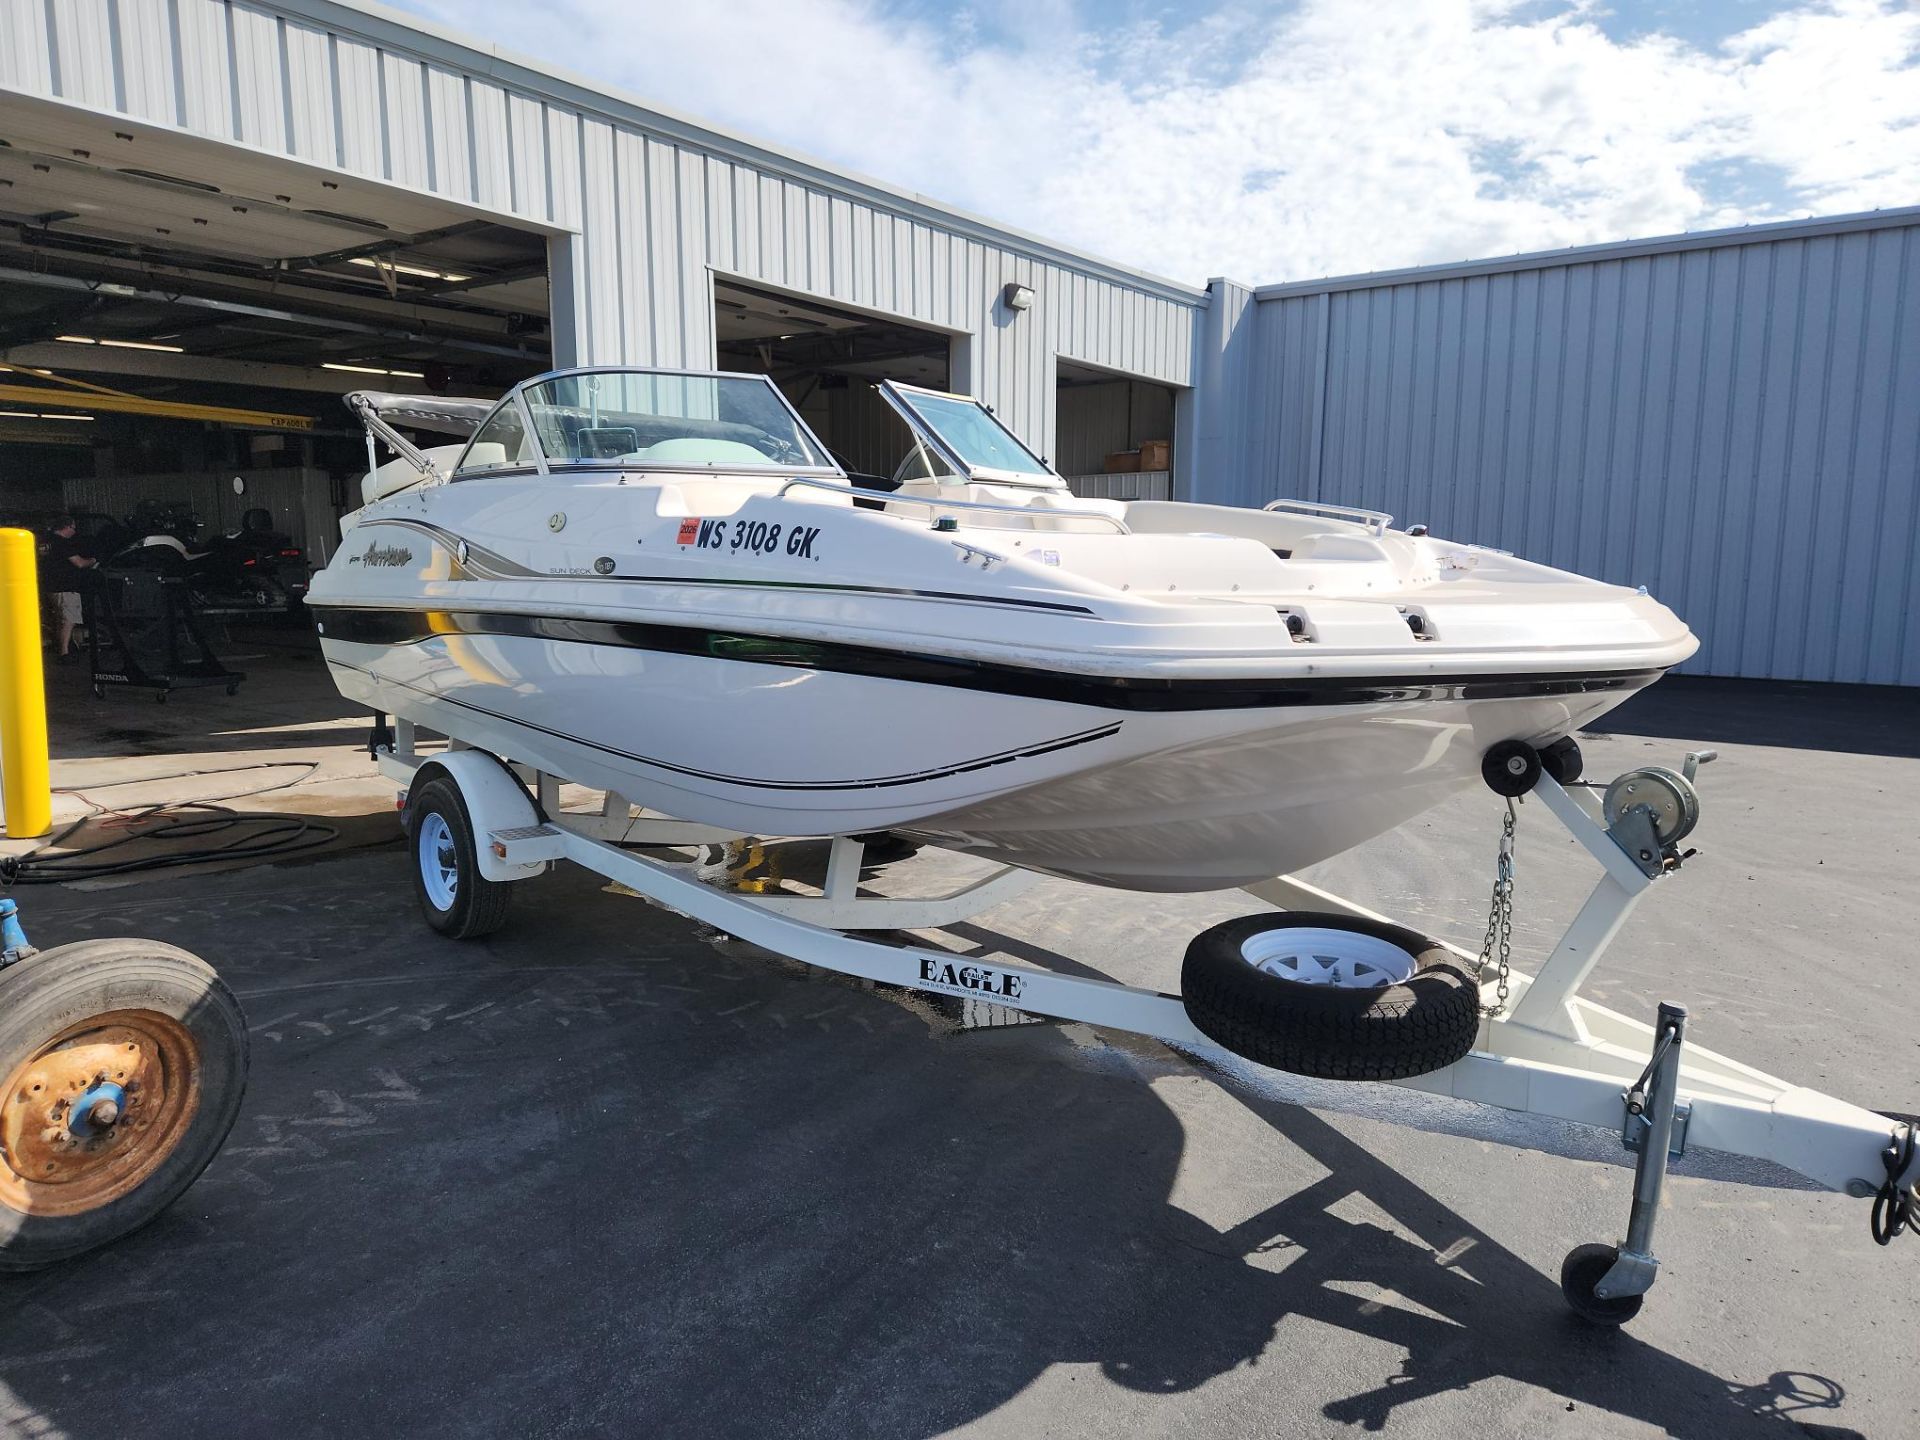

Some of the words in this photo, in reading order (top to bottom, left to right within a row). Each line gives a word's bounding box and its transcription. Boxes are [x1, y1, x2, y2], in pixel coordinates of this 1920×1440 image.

[697, 519, 727, 549] WS
[730, 519, 782, 553] 3108
[786, 525, 821, 558] GK
[95, 673, 129, 682] HONDA
[918, 958, 1022, 998] EAGLE
[963, 970, 989, 981] TRAILER
